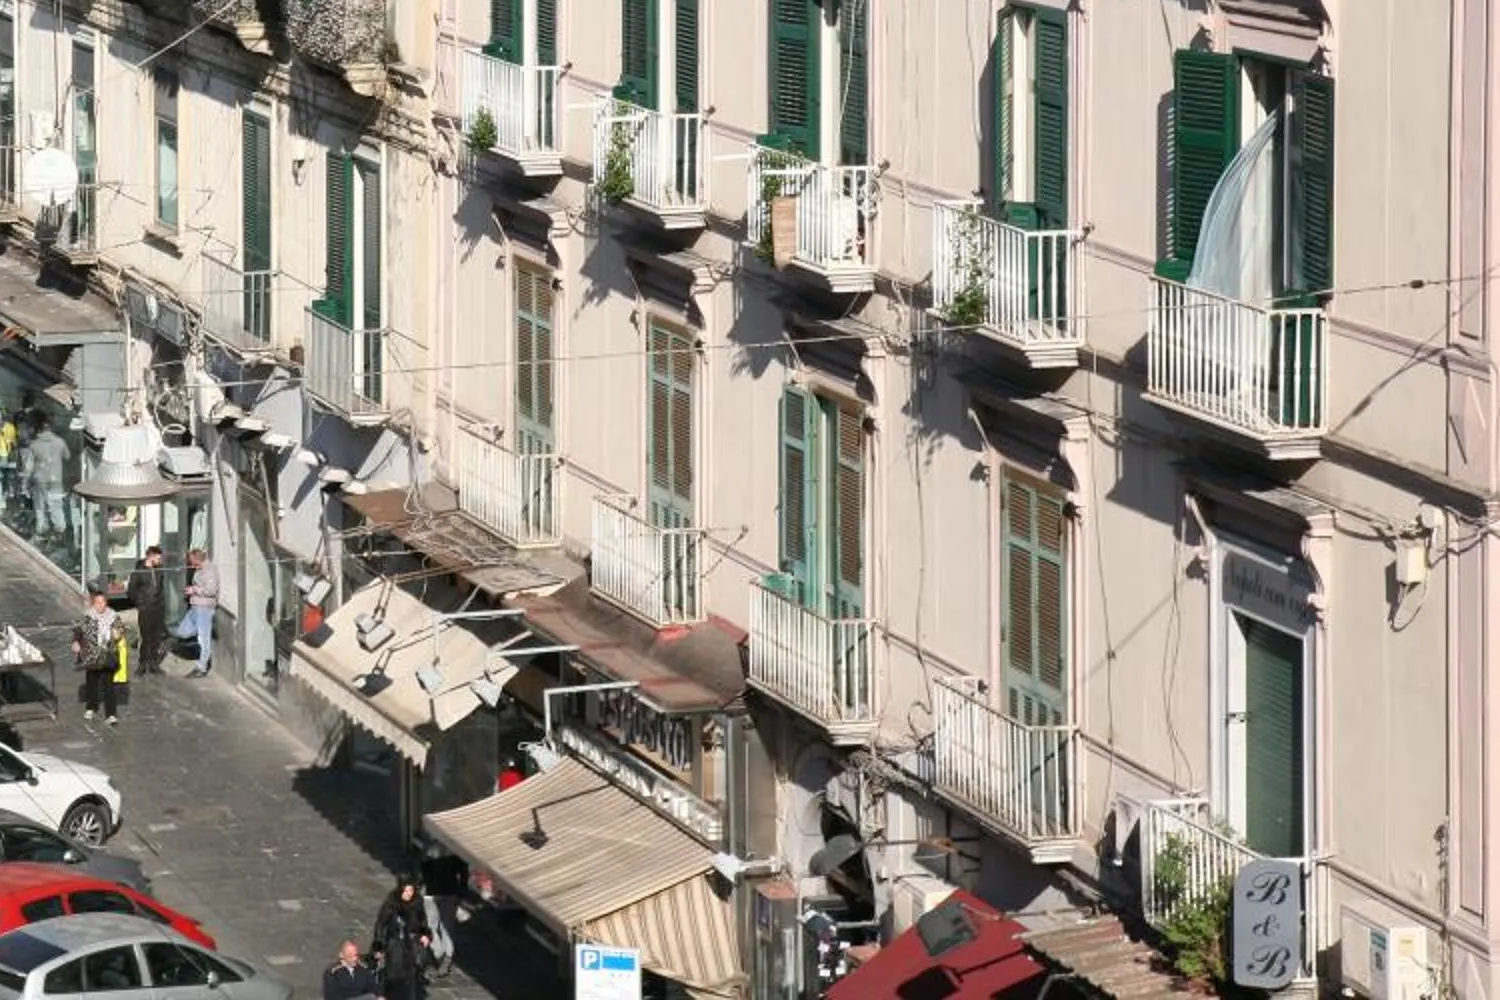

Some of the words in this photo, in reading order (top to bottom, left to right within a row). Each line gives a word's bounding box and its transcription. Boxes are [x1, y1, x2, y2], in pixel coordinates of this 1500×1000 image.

[1245, 871, 1290, 905] B
[1252, 914, 1280, 937] &
[1245, 943, 1290, 978] B
